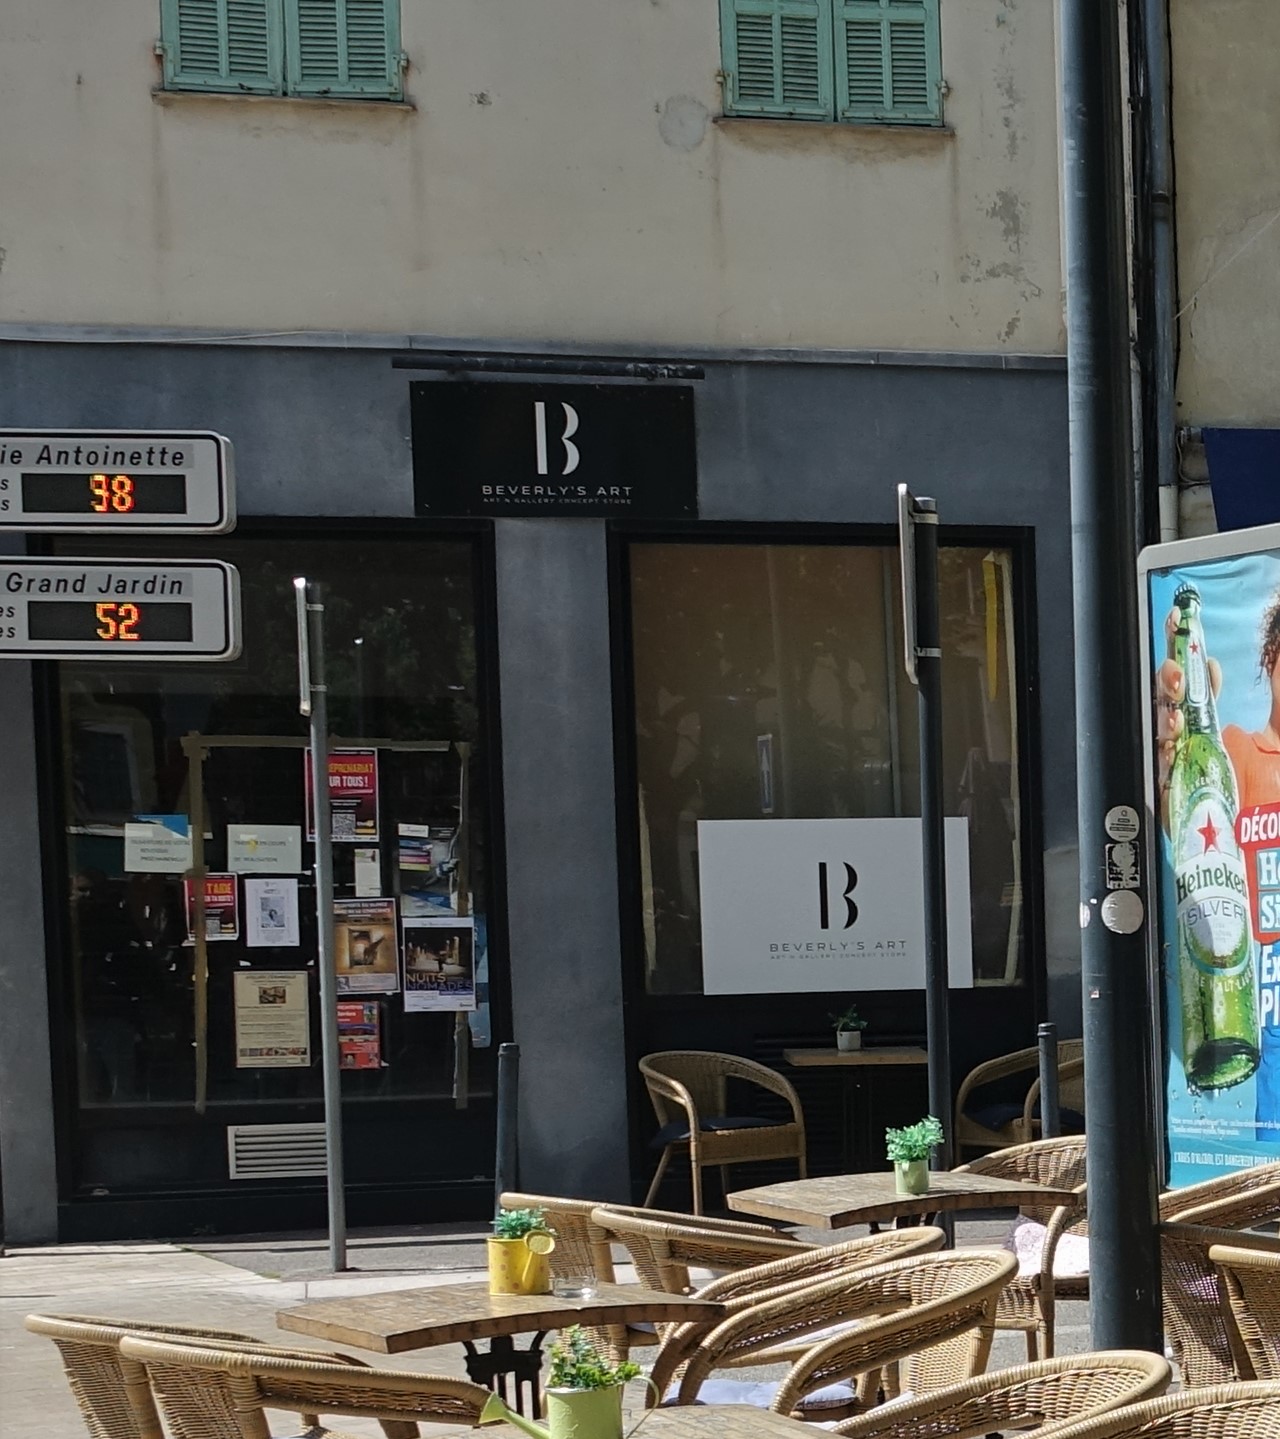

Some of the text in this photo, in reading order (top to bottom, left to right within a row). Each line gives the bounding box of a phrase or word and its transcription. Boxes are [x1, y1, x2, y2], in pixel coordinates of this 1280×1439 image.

[534, 401, 581, 475] B
[36, 444, 185, 467] Antoinette
[481, 485, 634, 496] BEVERLY'S ART
[5, 572, 184, 595] Grand Jardin
[95, 602, 141, 641] 52
[818, 861, 859, 930] B
[1187, 899, 1245, 927] SILVER
[769, 939, 907, 953] BEVERLY'S ART
[407, 972, 447, 983] NUITS
[407, 981, 473, 991] NOMADES
